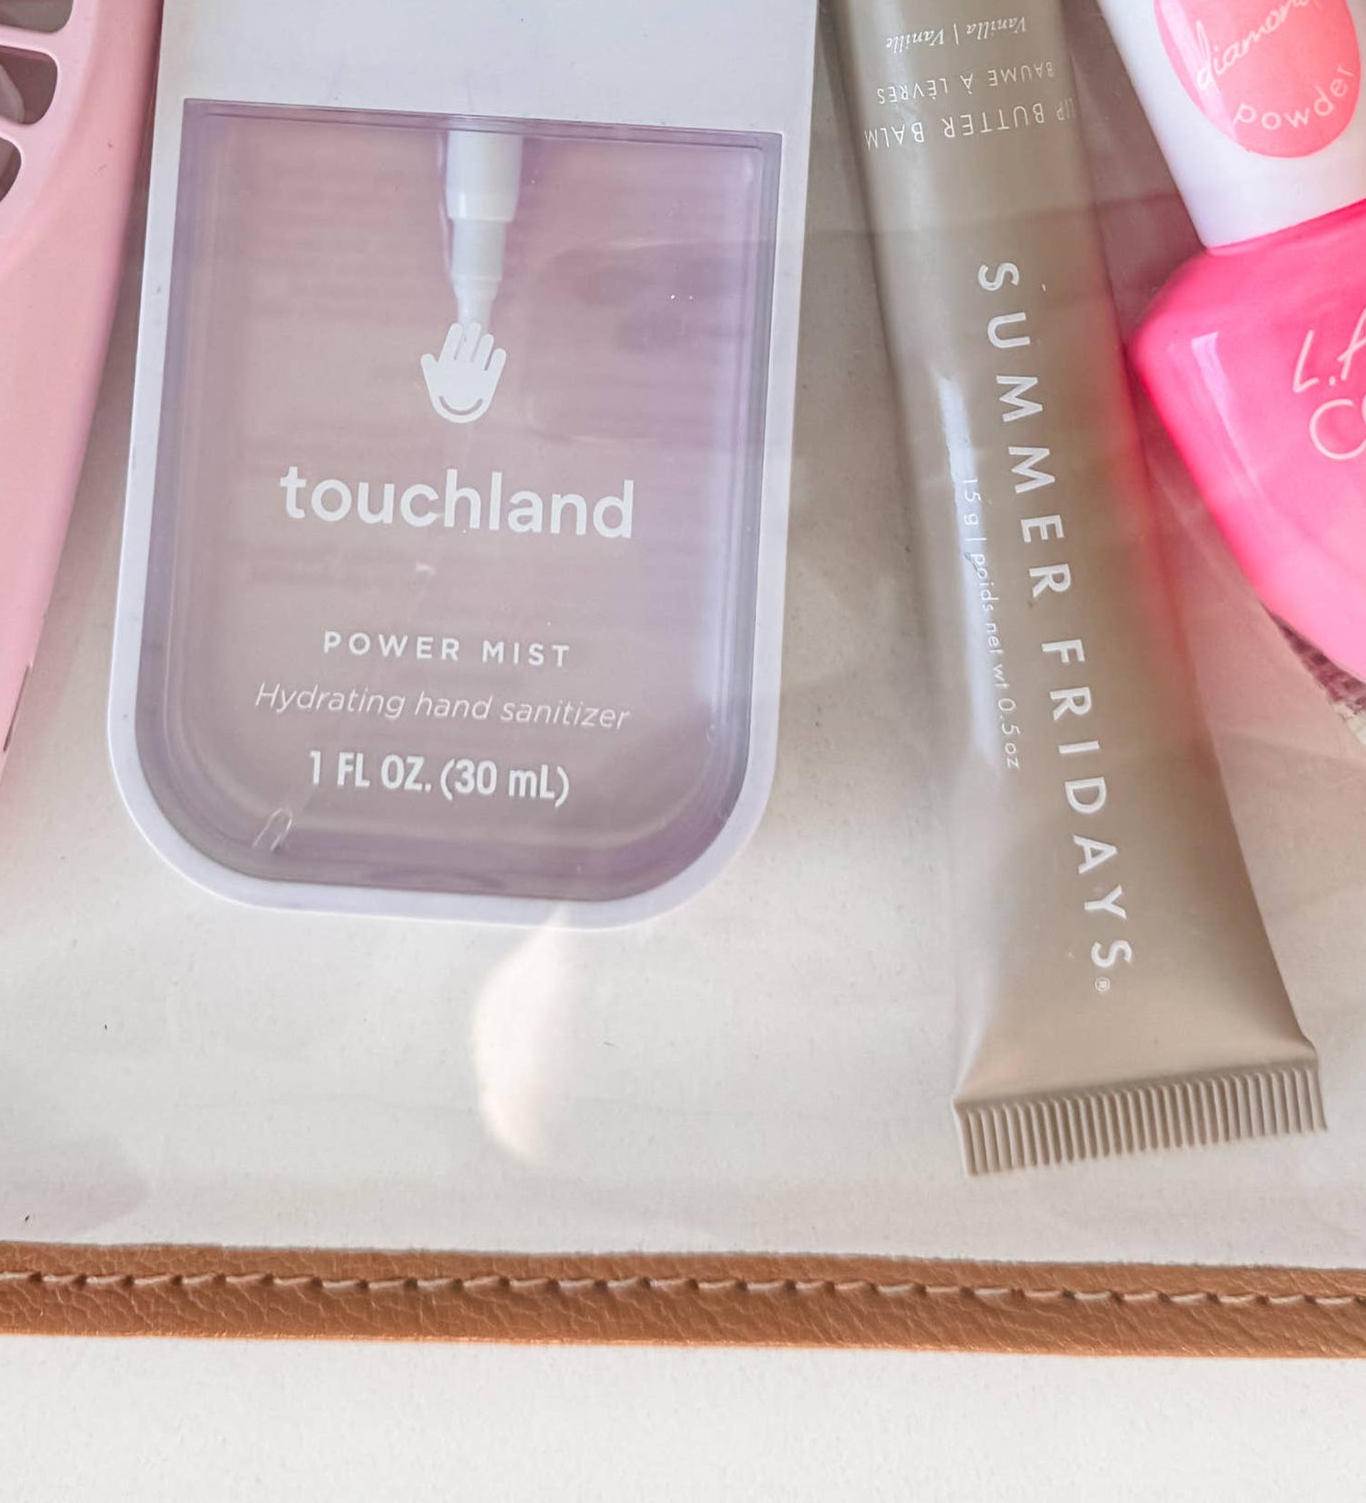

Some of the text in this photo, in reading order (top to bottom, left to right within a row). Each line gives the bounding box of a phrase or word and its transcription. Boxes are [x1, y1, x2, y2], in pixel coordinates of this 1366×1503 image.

[885, 27, 945, 54] Vanille
[965, 16, 1027, 42] Vanilla
[876, 60, 1055, 105] BAUME À LÈVRES
[1233, 64, 1354, 131] powder
[863, 120, 925, 151] BALM
[941, 102, 1044, 139] BUTTER
[977, 261, 1071, 597] SUMMER
[279, 465, 634, 539] touchland
[963, 478, 982, 502] 15
[963, 513, 979, 526] g
[970, 553, 999, 611] poids
[322, 630, 571, 667] POWER MIST
[985, 622, 1004, 655] net
[992, 664, 1010, 689] wt
[255, 682, 631, 730] Hydrating hand sanitizer
[997, 698, 1021, 735] 0.5
[1004, 742, 1020, 770] oz
[308, 750, 571, 807] 1 FL OZ. (30 mL)
